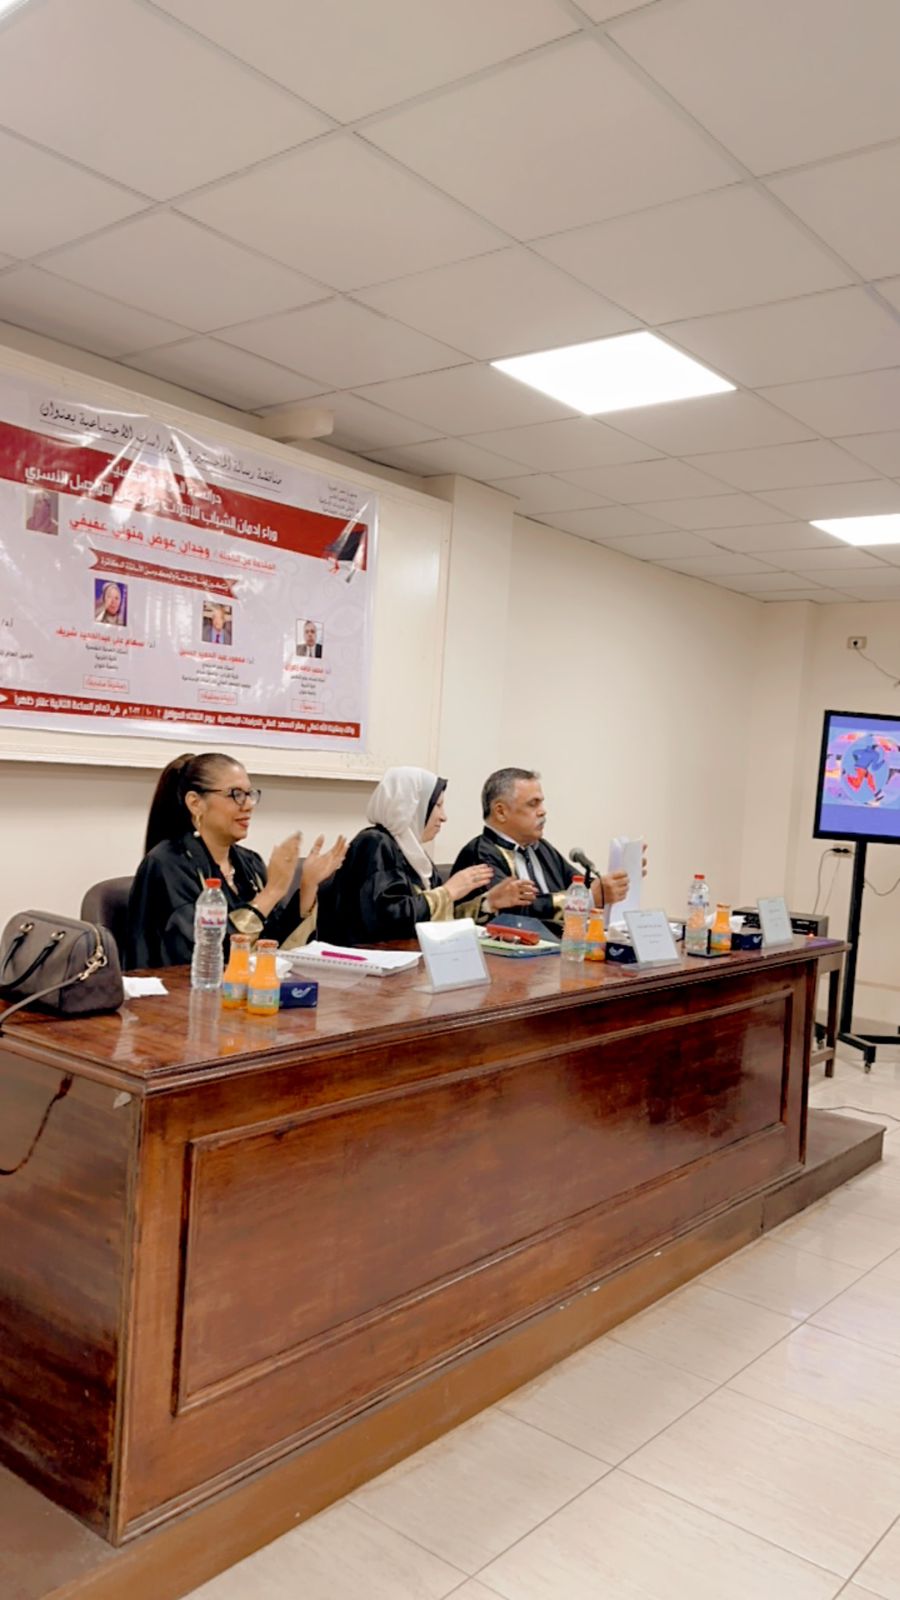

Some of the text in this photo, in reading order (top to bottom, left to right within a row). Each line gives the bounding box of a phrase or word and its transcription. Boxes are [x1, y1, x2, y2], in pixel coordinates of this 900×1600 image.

[39, 400, 77, 426] بعنوان
[68, 512, 108, 533] عفيفي
[201, 511, 237, 530] الشباب
[148, 532, 177, 550] عوض
[179, 541, 211, 559] وجدان
